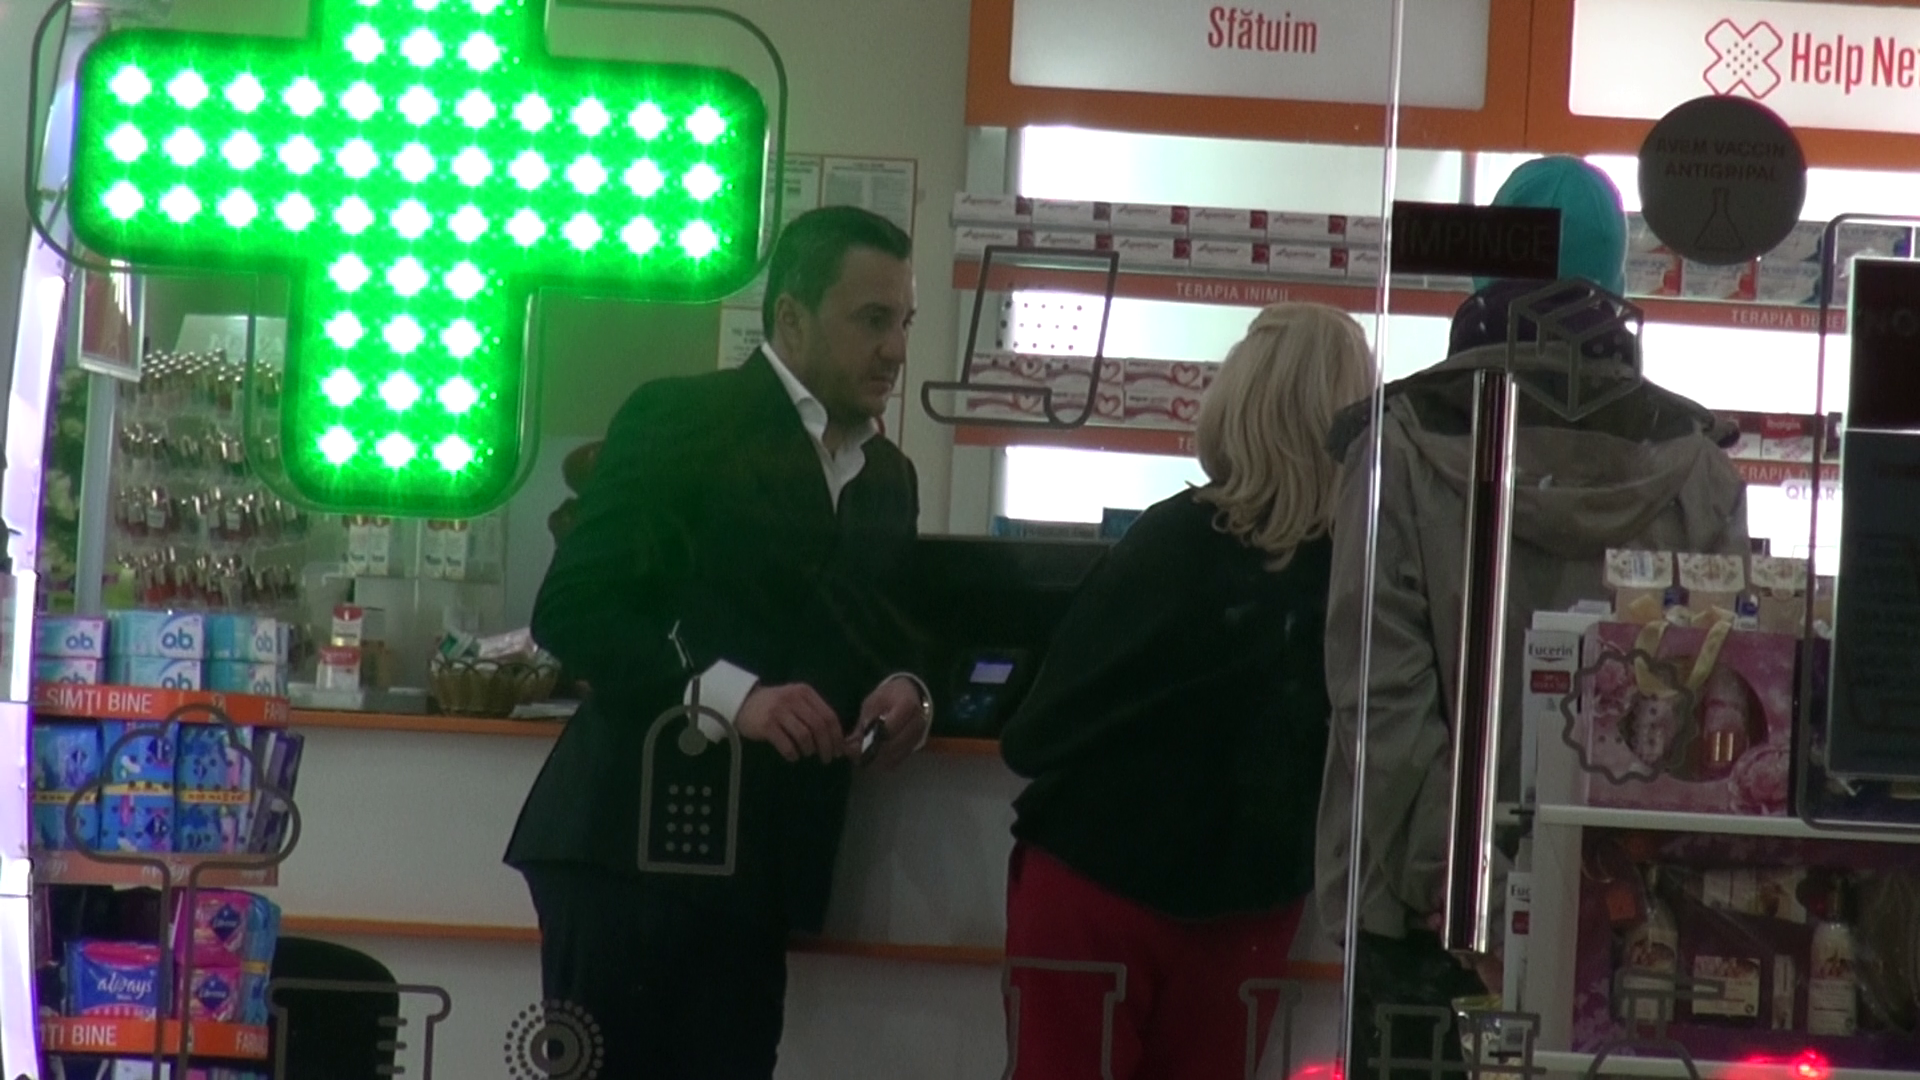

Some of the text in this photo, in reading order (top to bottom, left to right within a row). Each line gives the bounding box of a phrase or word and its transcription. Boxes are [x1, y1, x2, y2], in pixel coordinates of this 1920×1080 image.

[1207, 6, 1317, 53] Sfătuim
[1790, 32, 1920, 95] Help Ne
[1399, 218, 1552, 264] IMPINGE
[1176, 282, 1239, 300] TERAPIA
[1732, 309, 1794, 327] TERAPIA
[1528, 643, 1574, 657] Eucerin
[108, 691, 152, 714] BINE
[97, 971, 153, 1000] always
[71, 1024, 117, 1047] BINE
